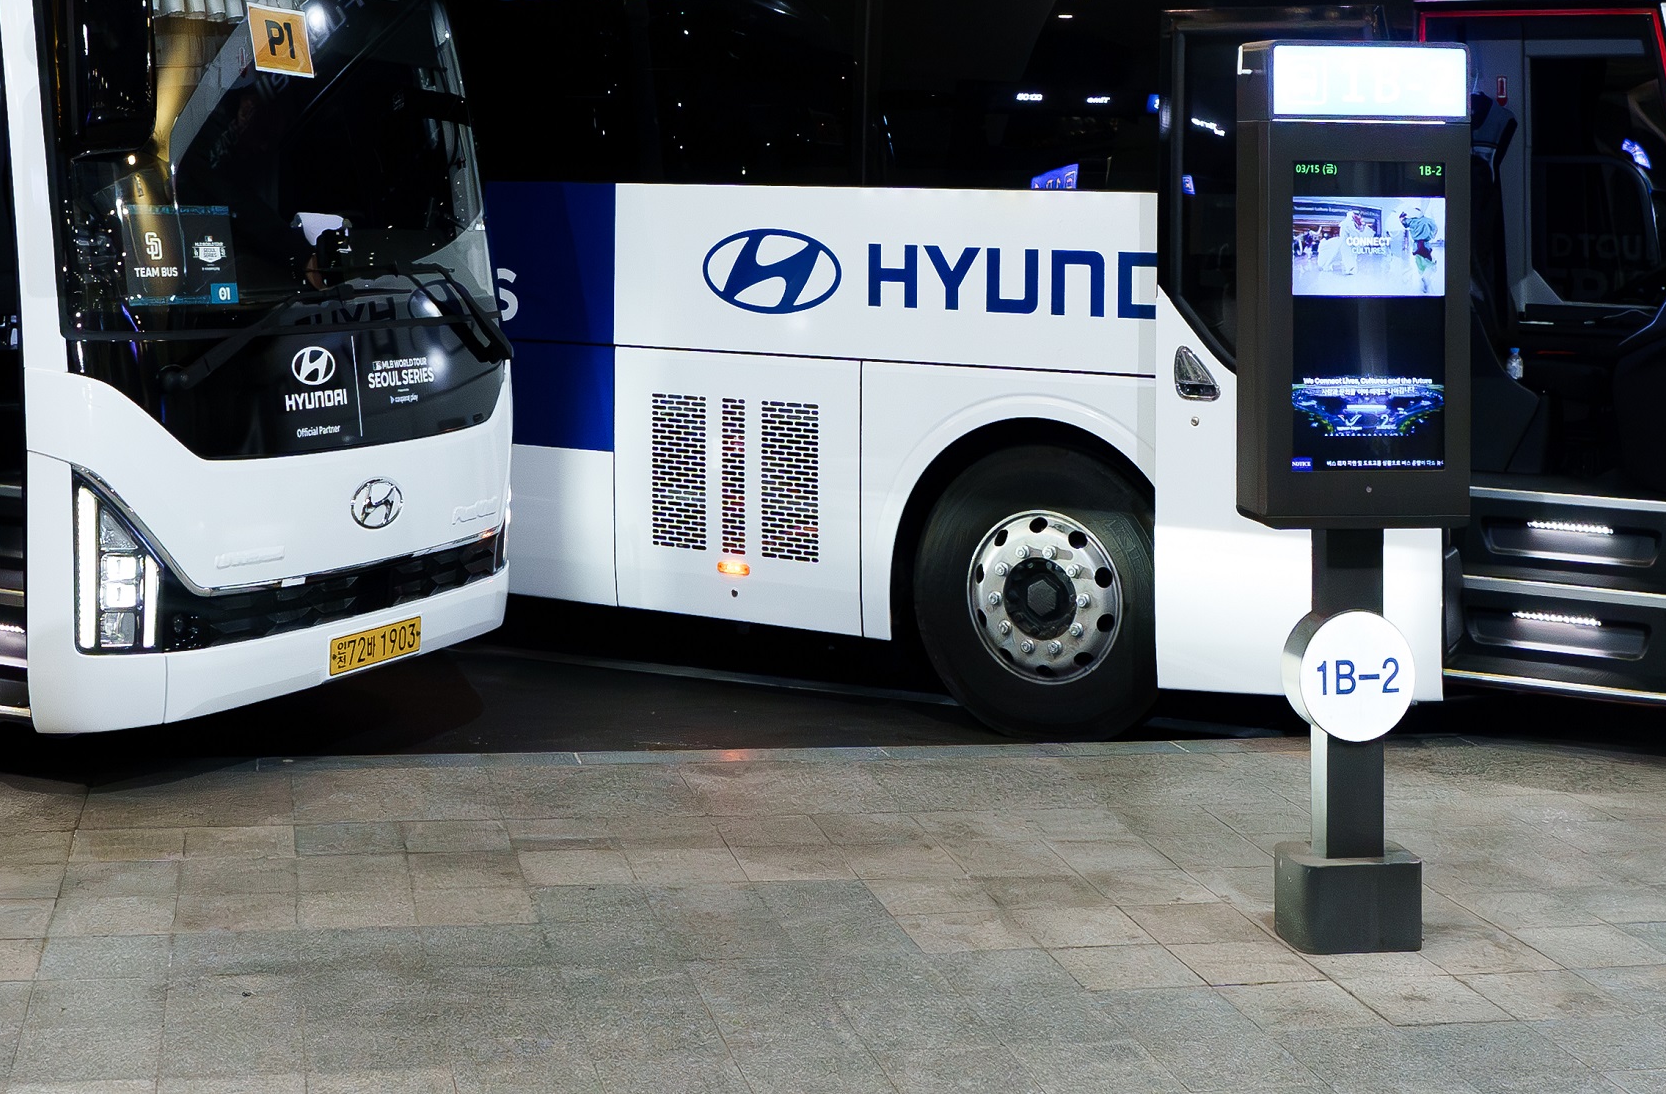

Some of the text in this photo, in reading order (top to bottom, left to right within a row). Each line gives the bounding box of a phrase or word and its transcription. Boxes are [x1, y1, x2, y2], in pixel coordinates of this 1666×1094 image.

[1295, 163, 1338, 175] 03/15 (금)
[1419, 165, 1442, 177] 1B-2
[1346, 237, 1391, 246] CONNECT
[134, 267, 179, 278] TEAM BUS
[868, 243, 1157, 319] HYUND
[218, 287, 231, 301] 01
[382, 357, 427, 370] MLB WORLD TOUR
[368, 367, 435, 389] SEOUL SERIES
[1315, 377, 1342, 385] Connect
[285, 389, 348, 412] HYUNDAI
[296, 424, 341, 438] Official Partner
[347, 635, 376, 666] 72바
[381, 623, 416, 656] 1903
[1317, 657, 1400, 696] 1B-2
